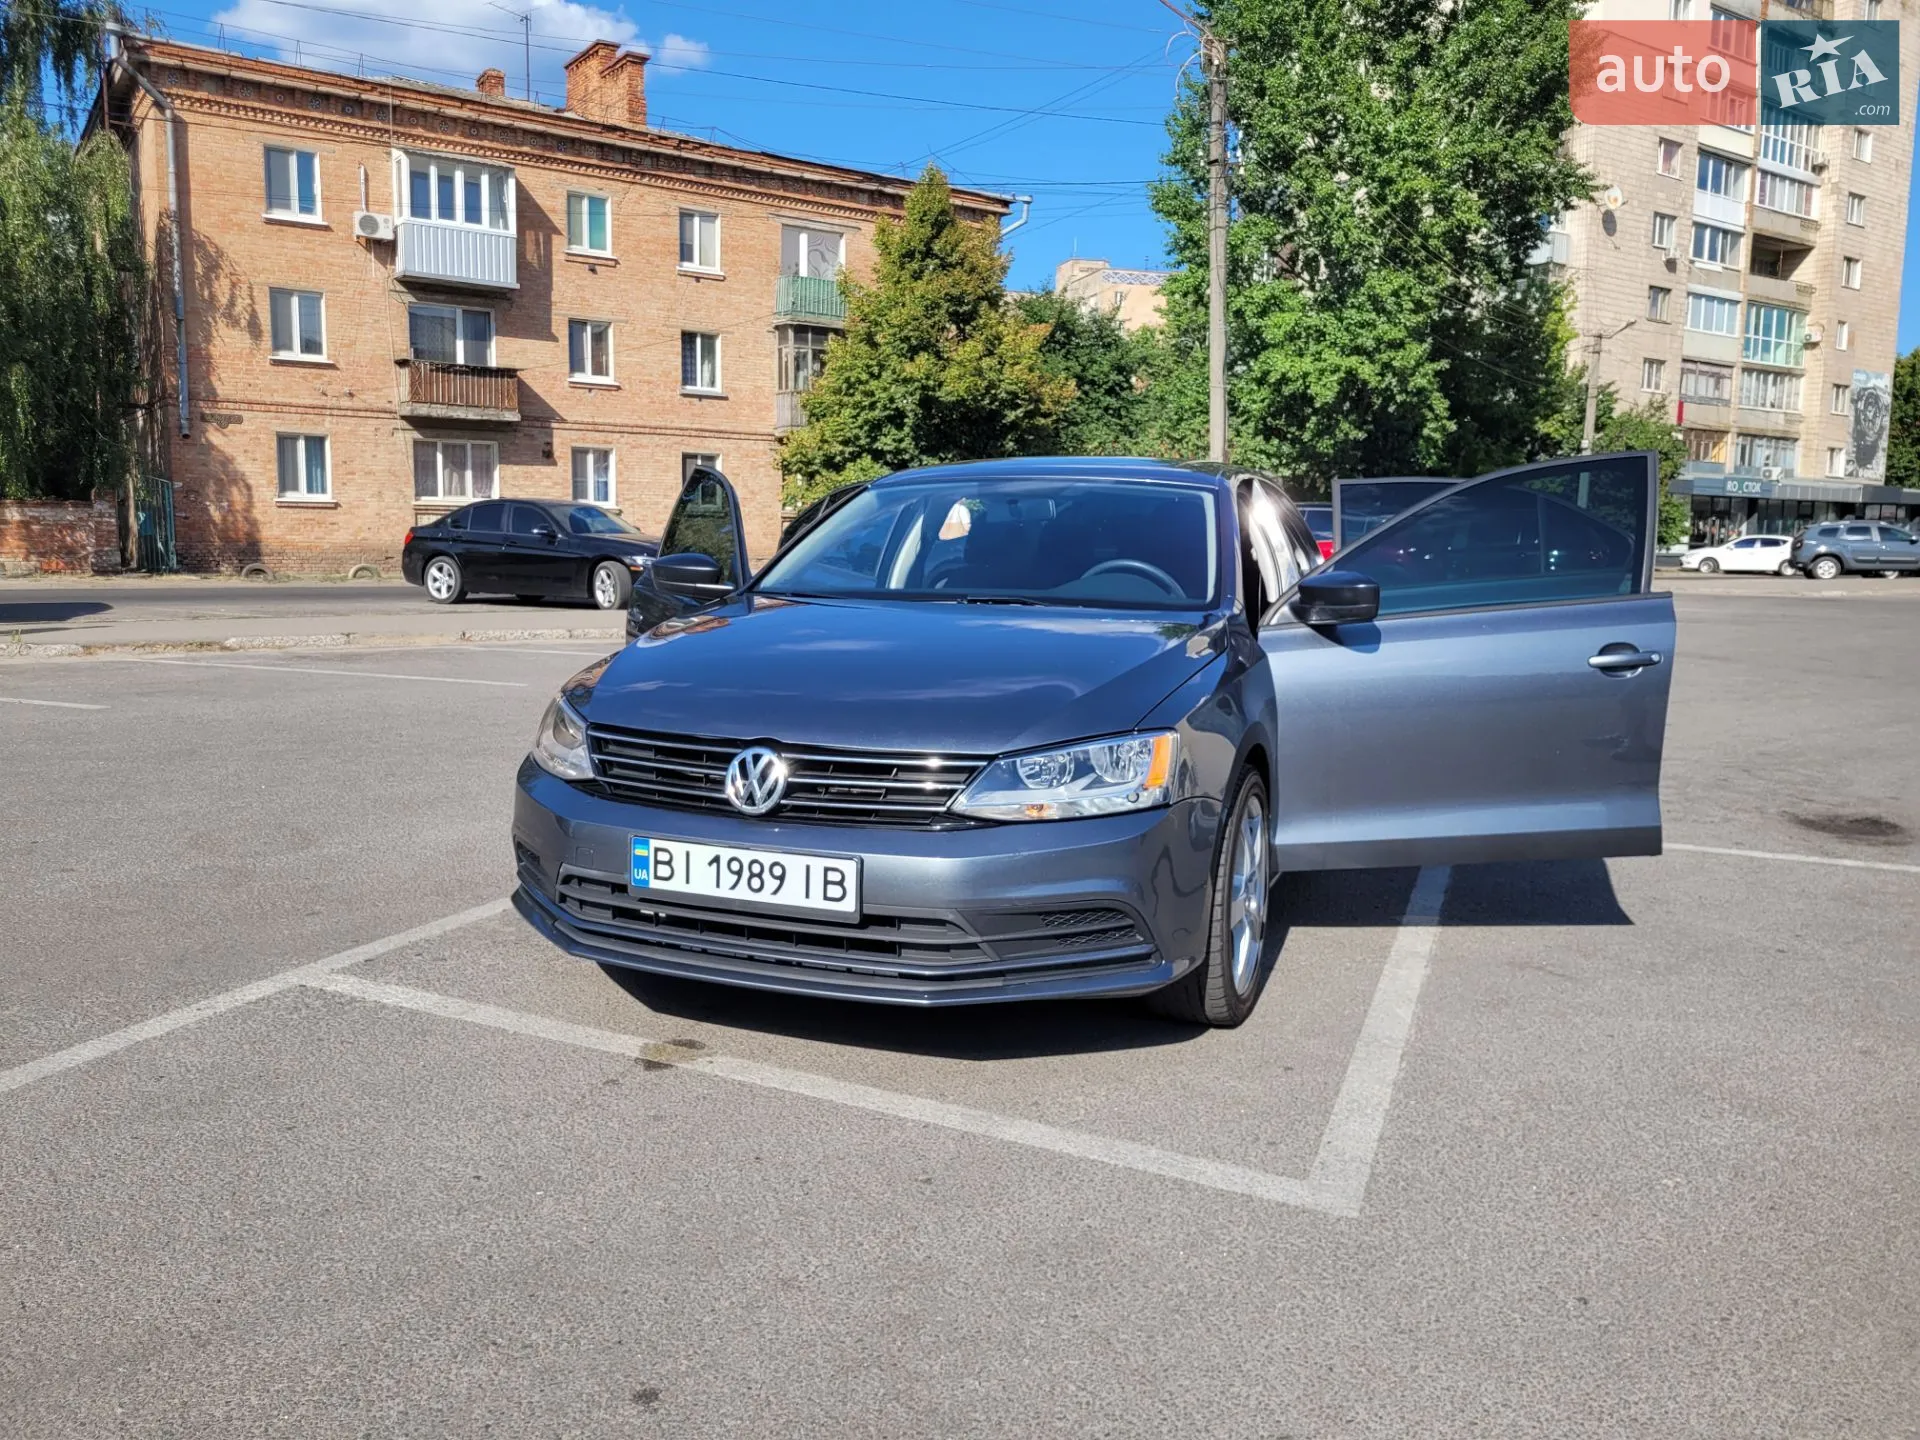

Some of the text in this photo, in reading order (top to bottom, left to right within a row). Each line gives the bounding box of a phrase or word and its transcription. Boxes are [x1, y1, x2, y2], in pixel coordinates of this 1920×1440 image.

[634, 868, 649, 881] UA
[653, 846, 847, 902] BI 1989 IB
